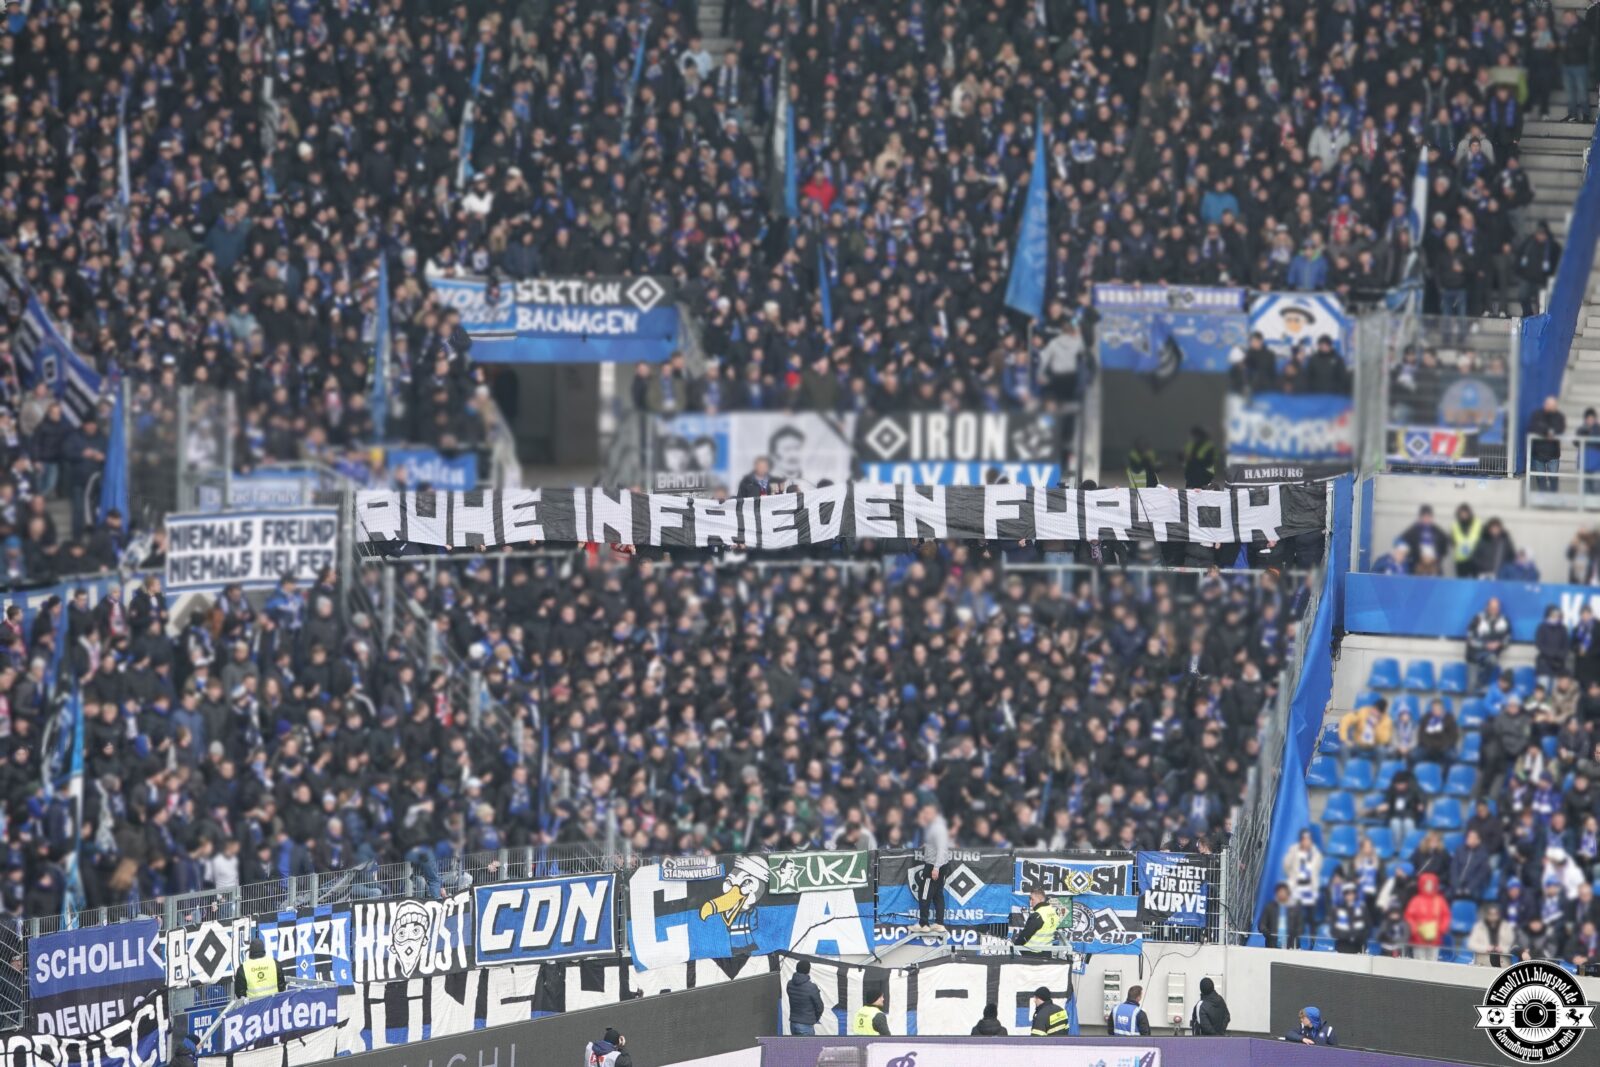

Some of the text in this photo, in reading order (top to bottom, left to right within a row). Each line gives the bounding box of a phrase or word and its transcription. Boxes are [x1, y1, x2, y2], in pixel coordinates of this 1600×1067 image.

[910, 412, 1008, 460] IRON
[1245, 467, 1304, 480] HAMBURG
[356, 483, 1282, 549] RUHE IN FRIEDEN FURTOK
[169, 519, 336, 551] NIEMALS FREUND
[168, 549, 333, 583] NIEMALS HELFER
[676, 857, 706, 866] SEKTION
[914, 851, 980, 862] HURG
[1146, 862, 1207, 880] FREIHEIT
[1021, 860, 1128, 896] SEK SH
[1151, 875, 1201, 893] FÜR DIE
[479, 880, 610, 952] CDN
[908, 909, 984, 921] HIGANS
[1144, 889, 1207, 914] KURVE
[261, 918, 350, 961] FORZA
[35, 936, 145, 984] SCHOLLI
[223, 997, 337, 1052] Rauten-
